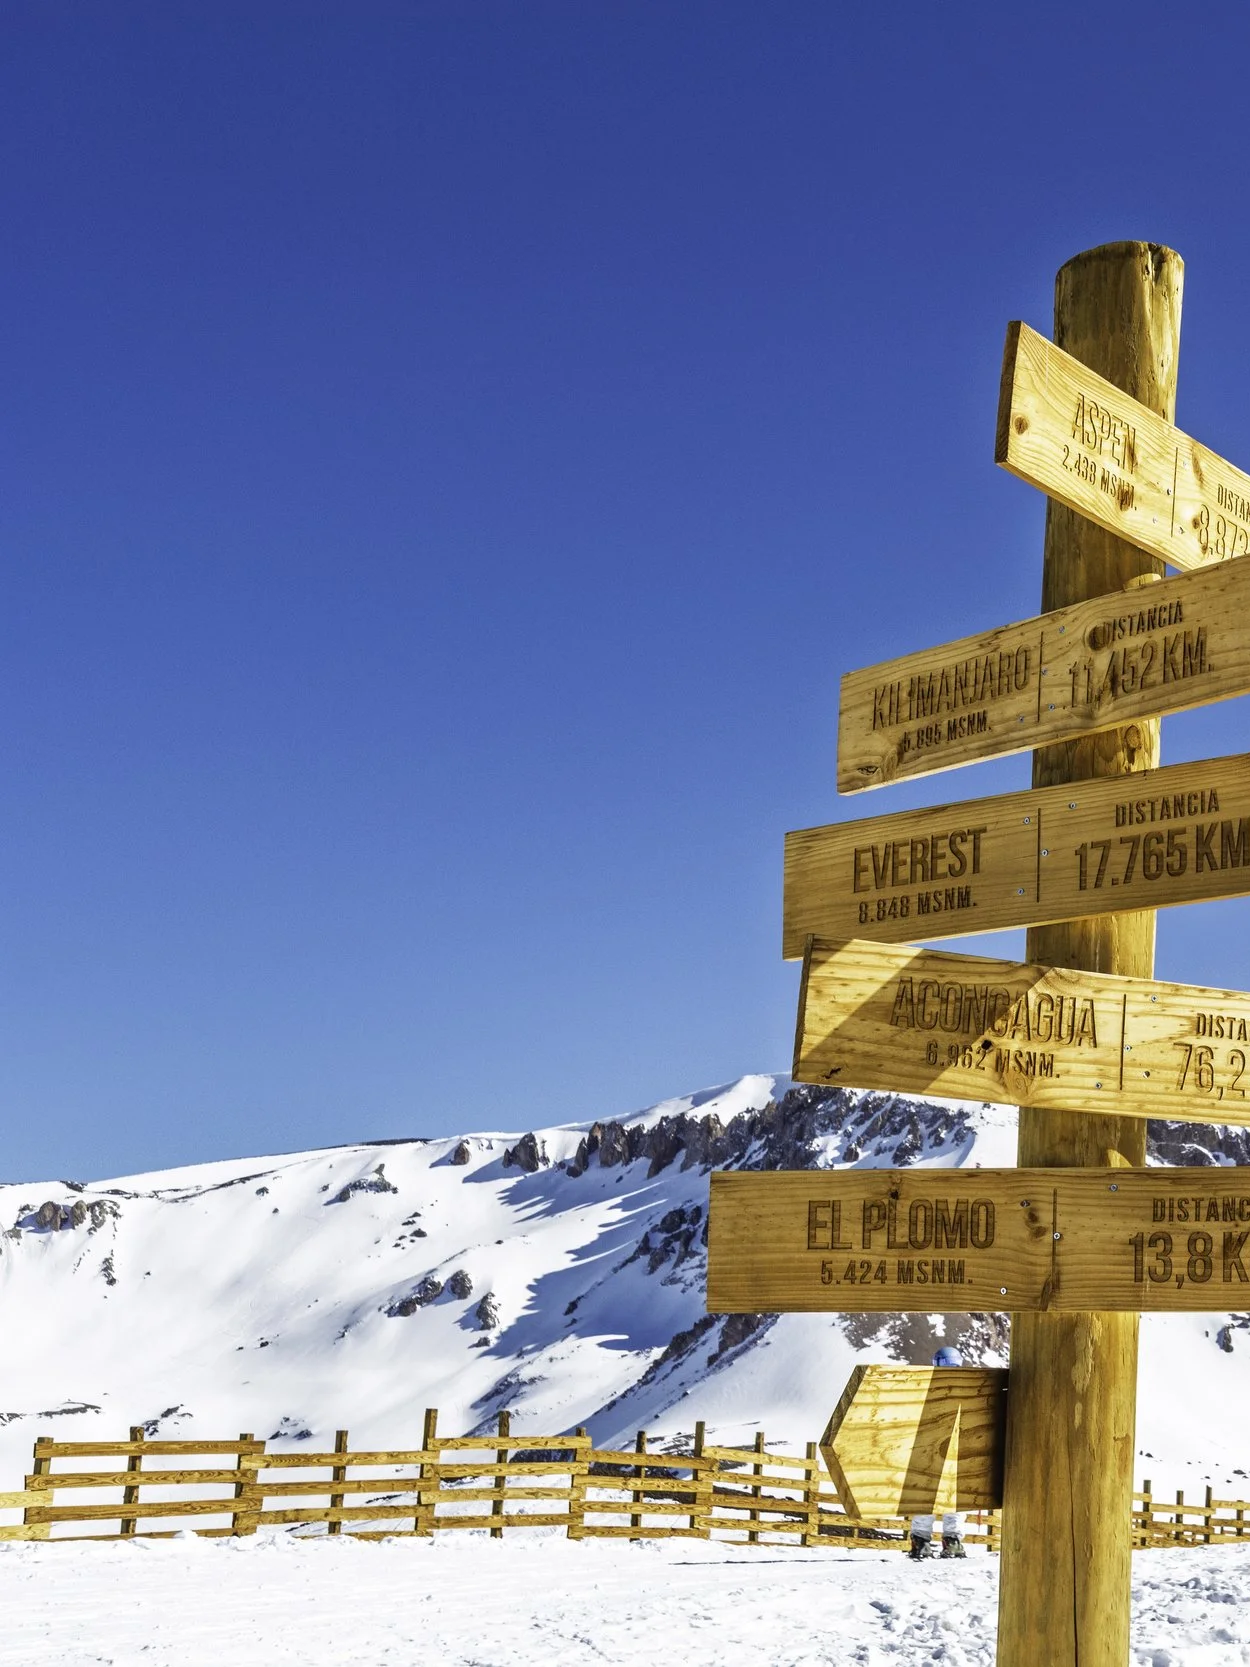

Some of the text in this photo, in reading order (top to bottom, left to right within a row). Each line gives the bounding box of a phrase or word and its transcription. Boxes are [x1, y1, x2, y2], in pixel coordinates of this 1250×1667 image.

[1072, 393, 1136, 476] ASPEN
[1062, 445, 1137, 511] 2.438 MSNM.
[1101, 600, 1183, 642] DISTANCIA
[1163, 625, 1214, 684] KM.
[872, 644, 1032, 731] KILIMANJARO
[902, 709, 993, 753] 5.895 MSNM.
[1115, 788, 1220, 828] DISTANCIA
[853, 825, 986, 894] EVEREST
[1074, 826, 1188, 891] 17.765
[858, 886, 978, 925] 8.848 MSNM.
[889, 975, 1098, 1049] ACONCAGUA
[925, 1038, 1061, 1080] 6.962 MSNM.
[1173, 1041, 1248, 1102] 76,2
[806, 1198, 996, 1251] EL PLOMO
[820, 1258, 975, 1286] 5.424 MSNM.
[1128, 1231, 1215, 1290] 13,8
